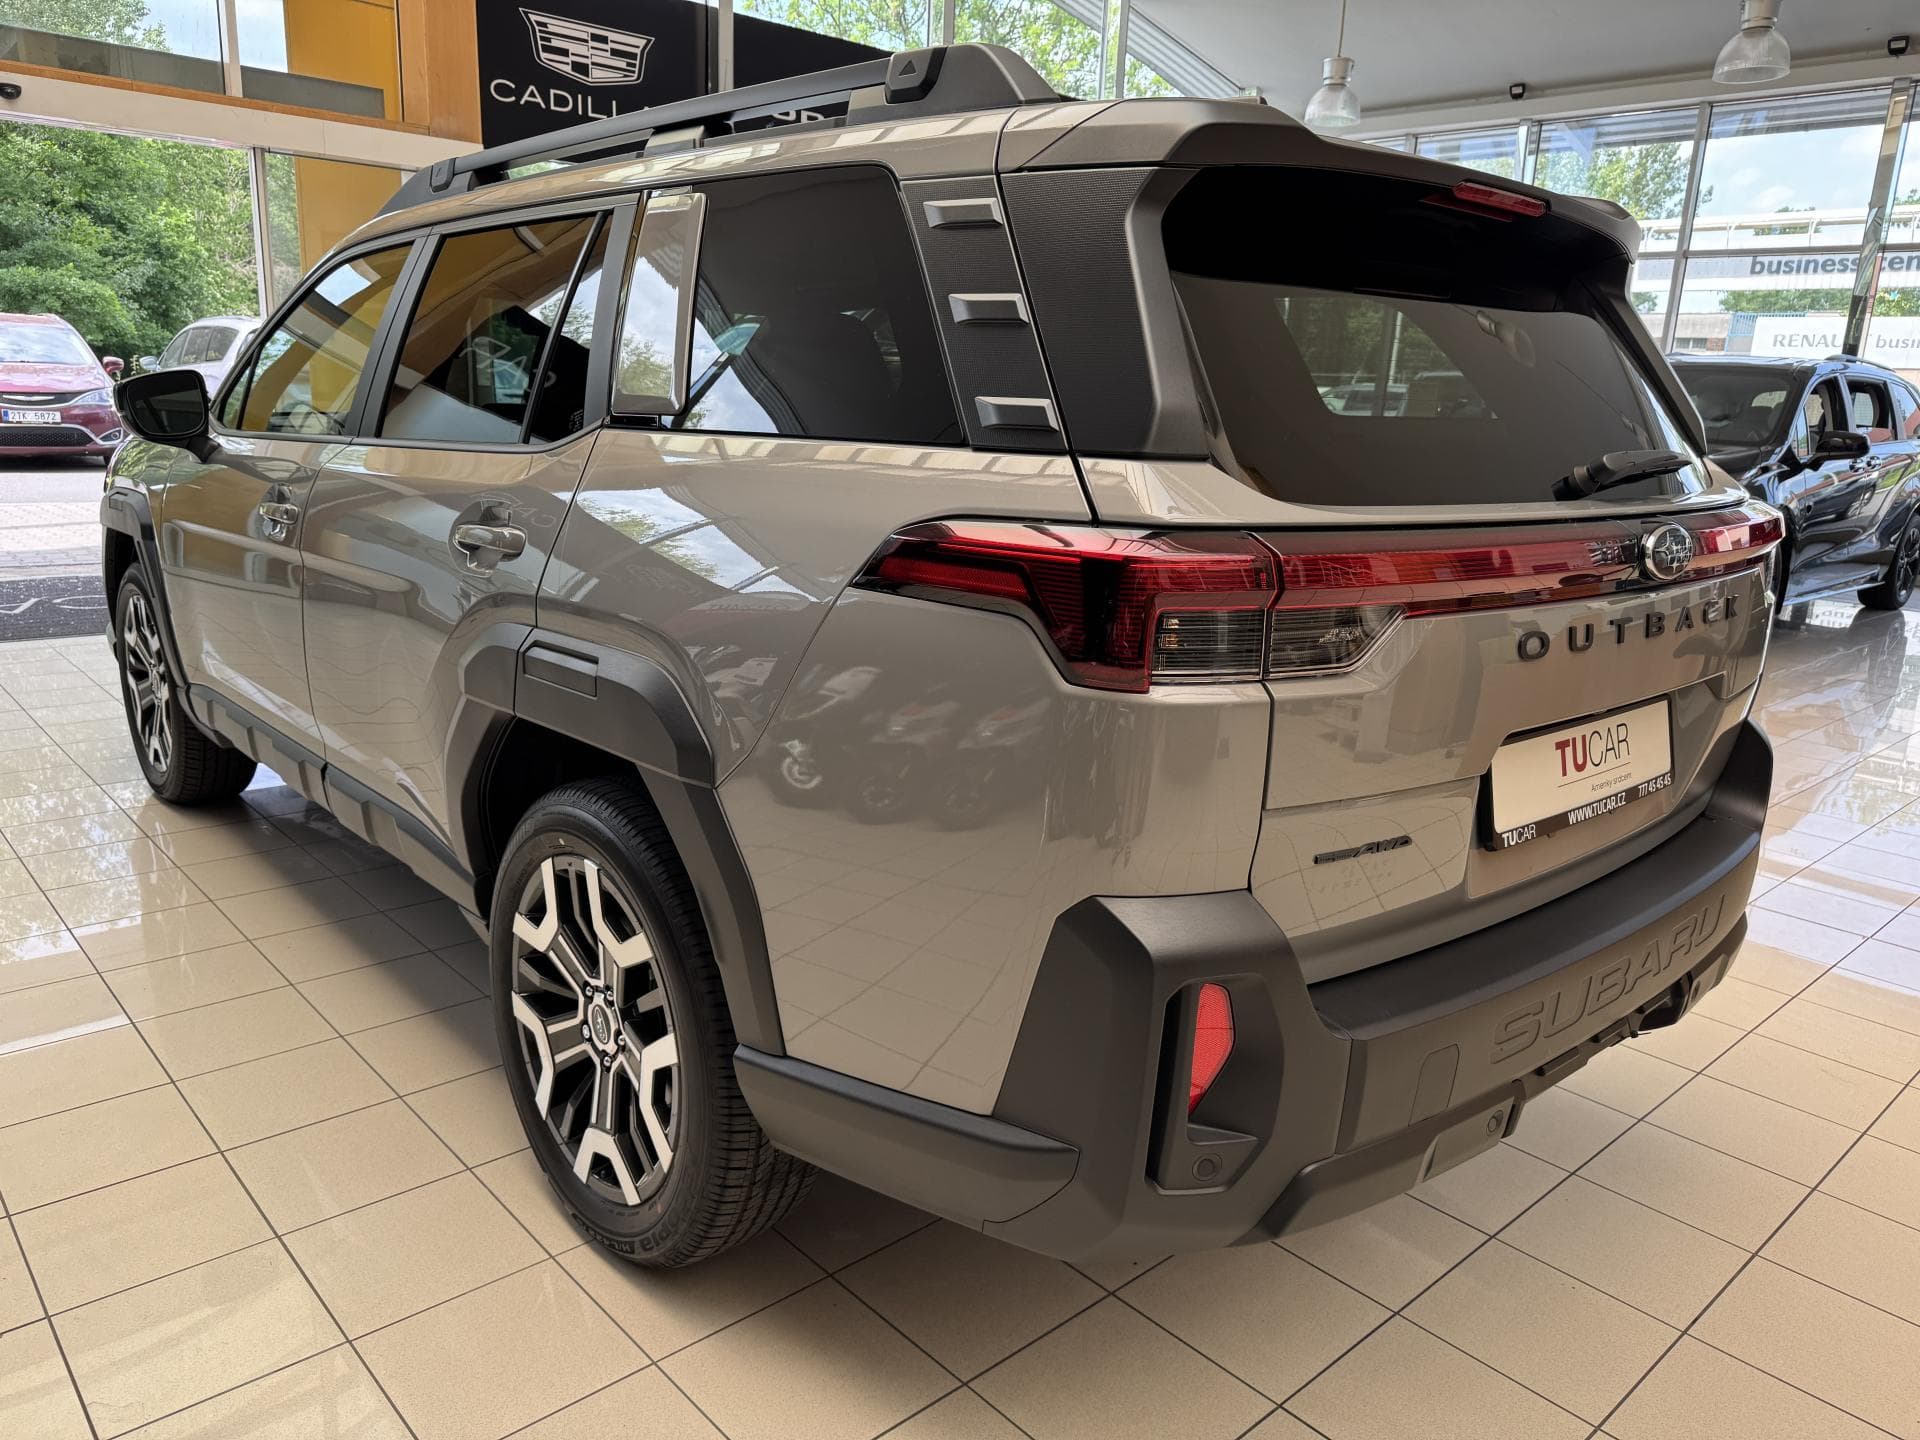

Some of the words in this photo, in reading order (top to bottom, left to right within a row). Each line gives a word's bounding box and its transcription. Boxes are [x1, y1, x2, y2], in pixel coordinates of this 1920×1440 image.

[490, 79, 649, 118] CADILL
[1750, 256, 1859, 275] business
[1517, 594, 1739, 661] OUTBACK
[1554, 722, 1631, 778] TUCAR
[1501, 824, 1537, 848] TUCAR
[1567, 792, 1627, 825] WWW.TUCAR.CZ
[1490, 894, 1727, 1066] SUBARU
